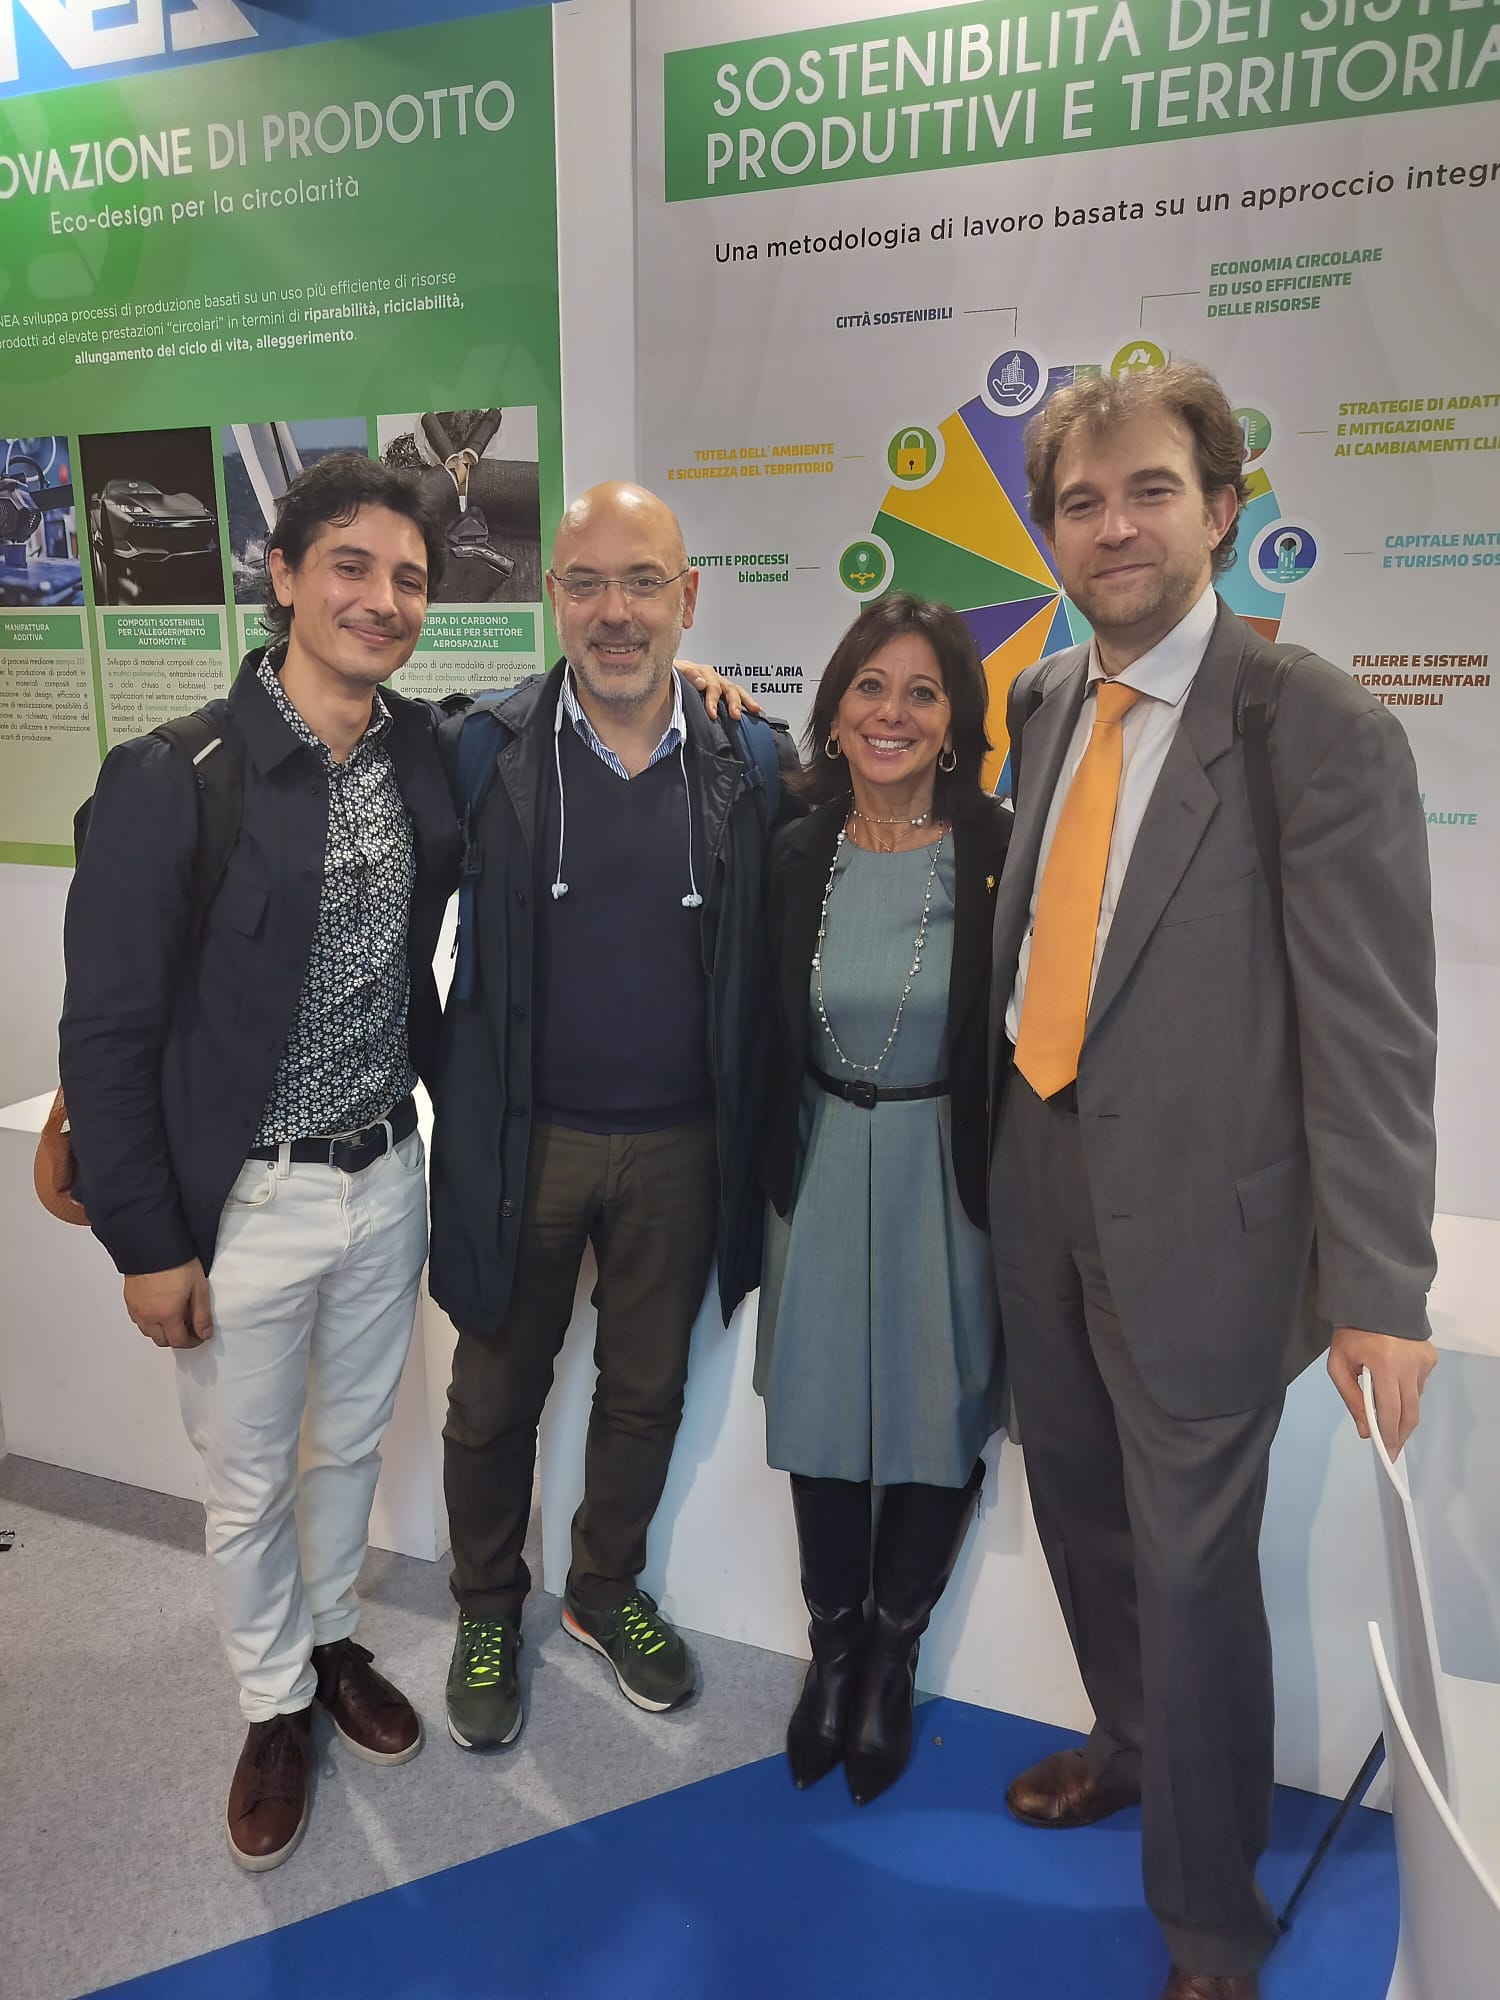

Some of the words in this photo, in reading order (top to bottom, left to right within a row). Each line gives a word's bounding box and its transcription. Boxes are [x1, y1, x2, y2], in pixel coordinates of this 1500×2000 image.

[1168, 0, 1270, 51] DEI
[707, 88, 1036, 184] PRODUTTIVI
[1063, 80, 1094, 139] E
[1121, 24, 1500, 131] TERRITORIA
[208, 120, 246, 169] DI
[263, 80, 515, 162] PRODOTTO
[51, 205, 162, 234] Eco-design
[172, 199, 205, 224] per
[213, 190, 233, 215] la
[242, 176, 359, 211] circolarità
[714, 242, 758, 263] Una
[767, 223, 920, 258] metodologia
[930, 218, 953, 240] di
[963, 213, 1044, 237] lavoro
[1054, 200, 1144, 228] basata
[1155, 198, 1185, 217] su
[1196, 192, 1230, 213] un
[1241, 171, 1394, 211] approccio
[1210, 257, 1293, 277] ECONOMIA
[1295, 248, 1383, 269] CIRCOLARE
[1208, 283, 1228, 298] ED
[1231, 280, 1263, 295] USO
[1265, 272, 1353, 292] EFFICIENTE
[23, 311, 68, 326] sviluppa
[72, 304, 117, 323] processi
[121, 303, 131, 316] di
[135, 297, 200, 317] produzione
[204, 292, 240, 308] basati
[244, 291, 257, 304] su
[261, 290, 277, 302] un
[280, 287, 302, 300] uso
[306, 283, 326, 300] più
[330, 276, 391, 296] efficiente
[395, 274, 407, 289] di
[411, 272, 456, 288] risorse
[1207, 302, 1252, 318] DELLE
[1254, 296, 1321, 314] RISORSE
[42, 331, 55, 346] ad
[59, 328, 98, 345] elevate
[102, 321, 164, 342] prestazioni
[228, 316, 238, 329] in
[242, 311, 285, 327] termini
[289, 309, 300, 323] di
[304, 301, 380, 323] riparabilità,
[384, 293, 464, 314] riciclabilità,
[836, 311, 871, 329] CITTÀ
[873, 307, 953, 326] SOSTENIBILI
[75, 347, 153, 365] allungamento
[157, 343, 175, 357] del
[179, 341, 207, 356] ciclo
[211, 339, 222, 353] di
[226, 337, 252, 352] vita,
[256, 328, 357, 350] alleggerimento.
[1338, 399, 1424, 417] STRATEGIE
[1427, 397, 1444, 412] DI
[1336, 423, 1347, 437] E
[1349, 418, 1456, 436] MITIGAZIONE
[1334, 443, 1351, 457] AI
[1354, 438, 1470, 456] CAMBIAMENTI
[1473, 436, 1500, 450] CLI
[694, 448, 737, 462] TUTELA
[668, 468, 675, 480] E
[676, 465, 737, 480] SICUREZZA
[740, 464, 761, 478] DEL
[763, 461, 834, 476] TERRITORIO
[1385, 534, 1460, 549] CAPITALE
[688, 556, 723, 567] DOTTI
[725, 555, 732, 566] E
[734, 554, 789, 566] PROCESSI
[1383, 556, 1393, 568] E
[1395, 554, 1469, 568] TURISMO
[738, 570, 789, 583] biobased
[4, 623, 50, 632] MANIFATTURA
[118, 618, 158, 627] COMPOSITI
[158, 618, 205, 627] SOSTENIBILI
[450, 616, 459, 625] DI
[461, 616, 508, 625] CARBONIO
[13, 633, 44, 641] ADDITIVA
[118, 628, 132, 636] PER
[133, 628, 206, 636] L'ALLEGGERIMENTO
[464, 628, 482, 636] PER
[483, 628, 523, 637] SETTORE
[138, 638, 187, 646] AUTOMOTIVE
[433, 639, 499, 648] AEROSPAZIALE
[496, 660, 537, 672] produzione
[1352, 654, 1409, 667] FILIERE
[1411, 654, 1421, 667] E
[1423, 654, 1488, 667] SISTEMI
[178, 681, 207, 690] biobased
[751, 683, 758, 693] E
[760, 682, 803, 693] SALUTE
[1372, 693, 1444, 706] TENIBILI
[1425, 812, 1478, 825] ALUTE
